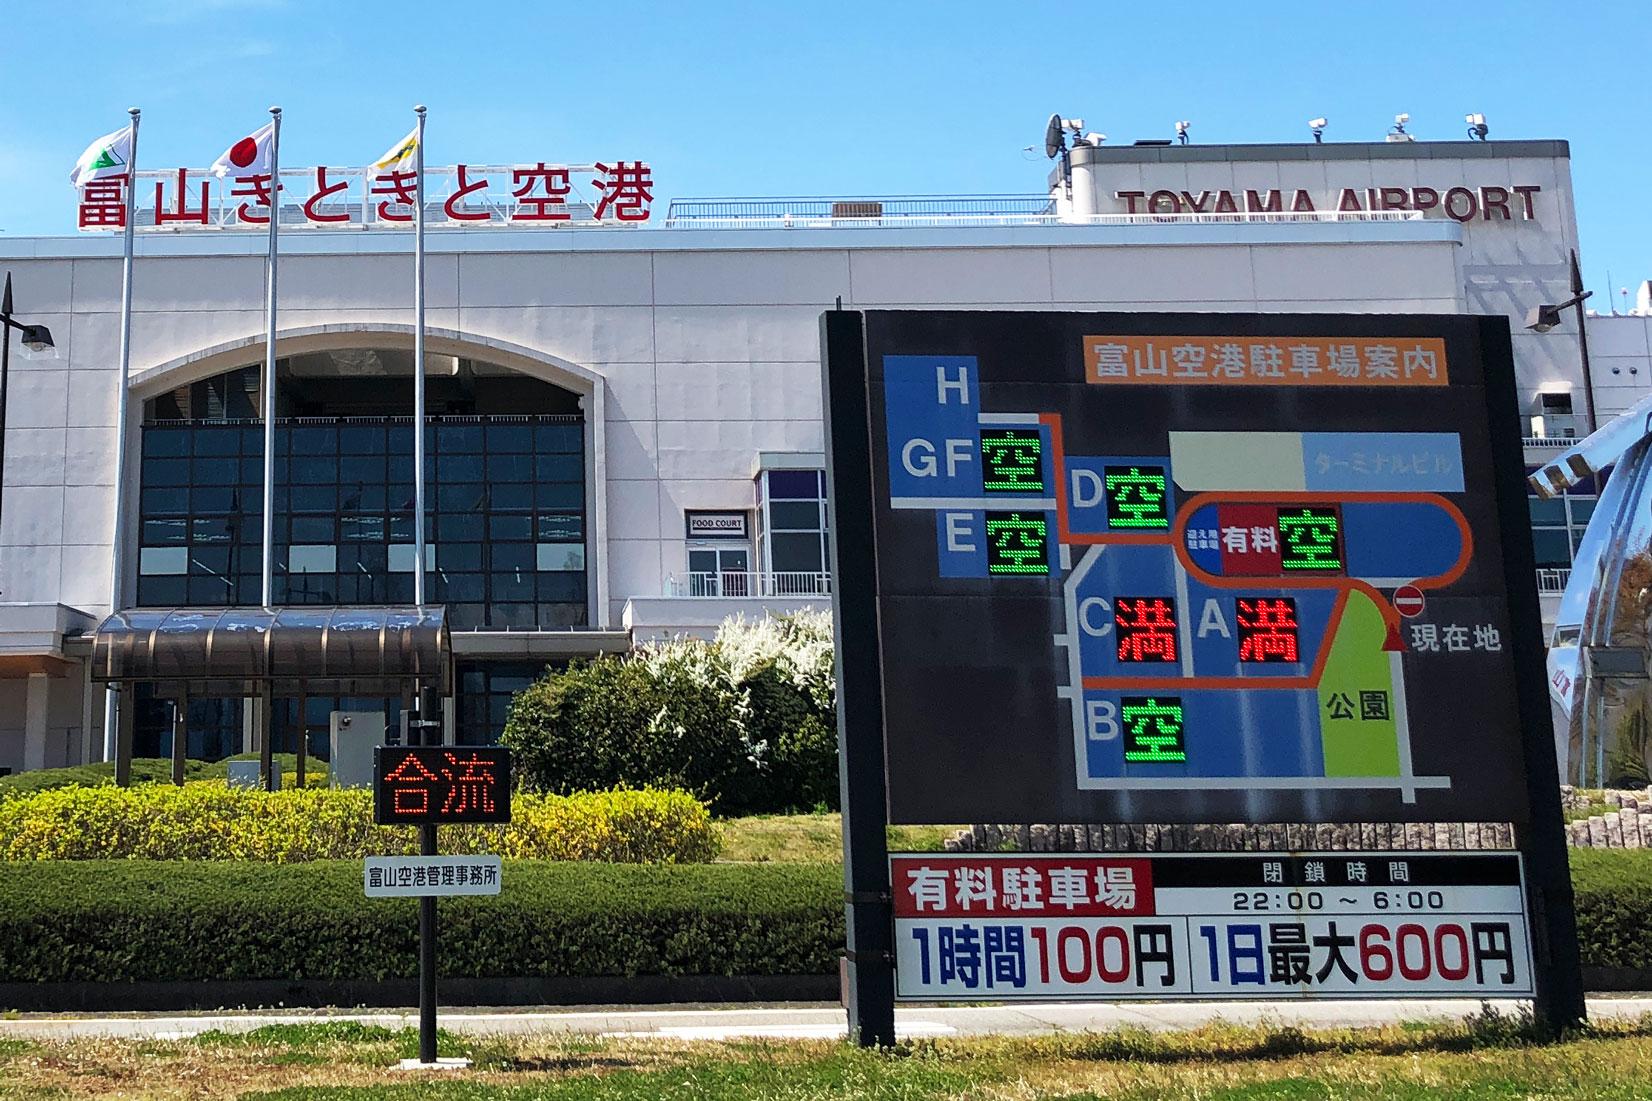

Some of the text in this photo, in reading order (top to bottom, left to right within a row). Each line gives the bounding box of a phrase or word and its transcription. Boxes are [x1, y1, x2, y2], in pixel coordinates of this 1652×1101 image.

[79, 161, 653, 227] 富山きときと空港
[1115, 185, 1541, 223] TOYAMA AIRPORT
[1093, 343, 1438, 380] 富山空港駐車場案内
[936, 366, 969, 405] H
[982, 431, 1044, 490] 空
[1071, 469, 1103, 508] D
[1106, 468, 1168, 528] 空
[692, 519, 741, 527] FOOD COURT
[946, 512, 976, 552] E
[987, 513, 1049, 573] 空
[1221, 526, 1278, 553] 有料
[1279, 510, 1341, 569] 空
[1078, 597, 1112, 637] C
[1115, 600, 1176, 662] 満
[1197, 599, 1231, 638] A
[1237, 600, 1298, 662] 満
[1411, 624, 1502, 652] 現在地
[1086, 701, 1119, 741] B
[1326, 690, 1390, 721] 公園
[1122, 699, 1185, 760] 空
[384, 752, 495, 813] 合流
[369, 865, 497, 887] 富山空港管理事務所
[907, 866, 1136, 911] 有料駐車場
[1263, 861, 1409, 883] 閉鎖時間
[1233, 891, 1324, 910] 22:00
[1374, 891, 1444, 910] 6:00
[912, 924, 1176, 989] 1時間100円
[1200, 921, 1515, 985] 1日最大600円
